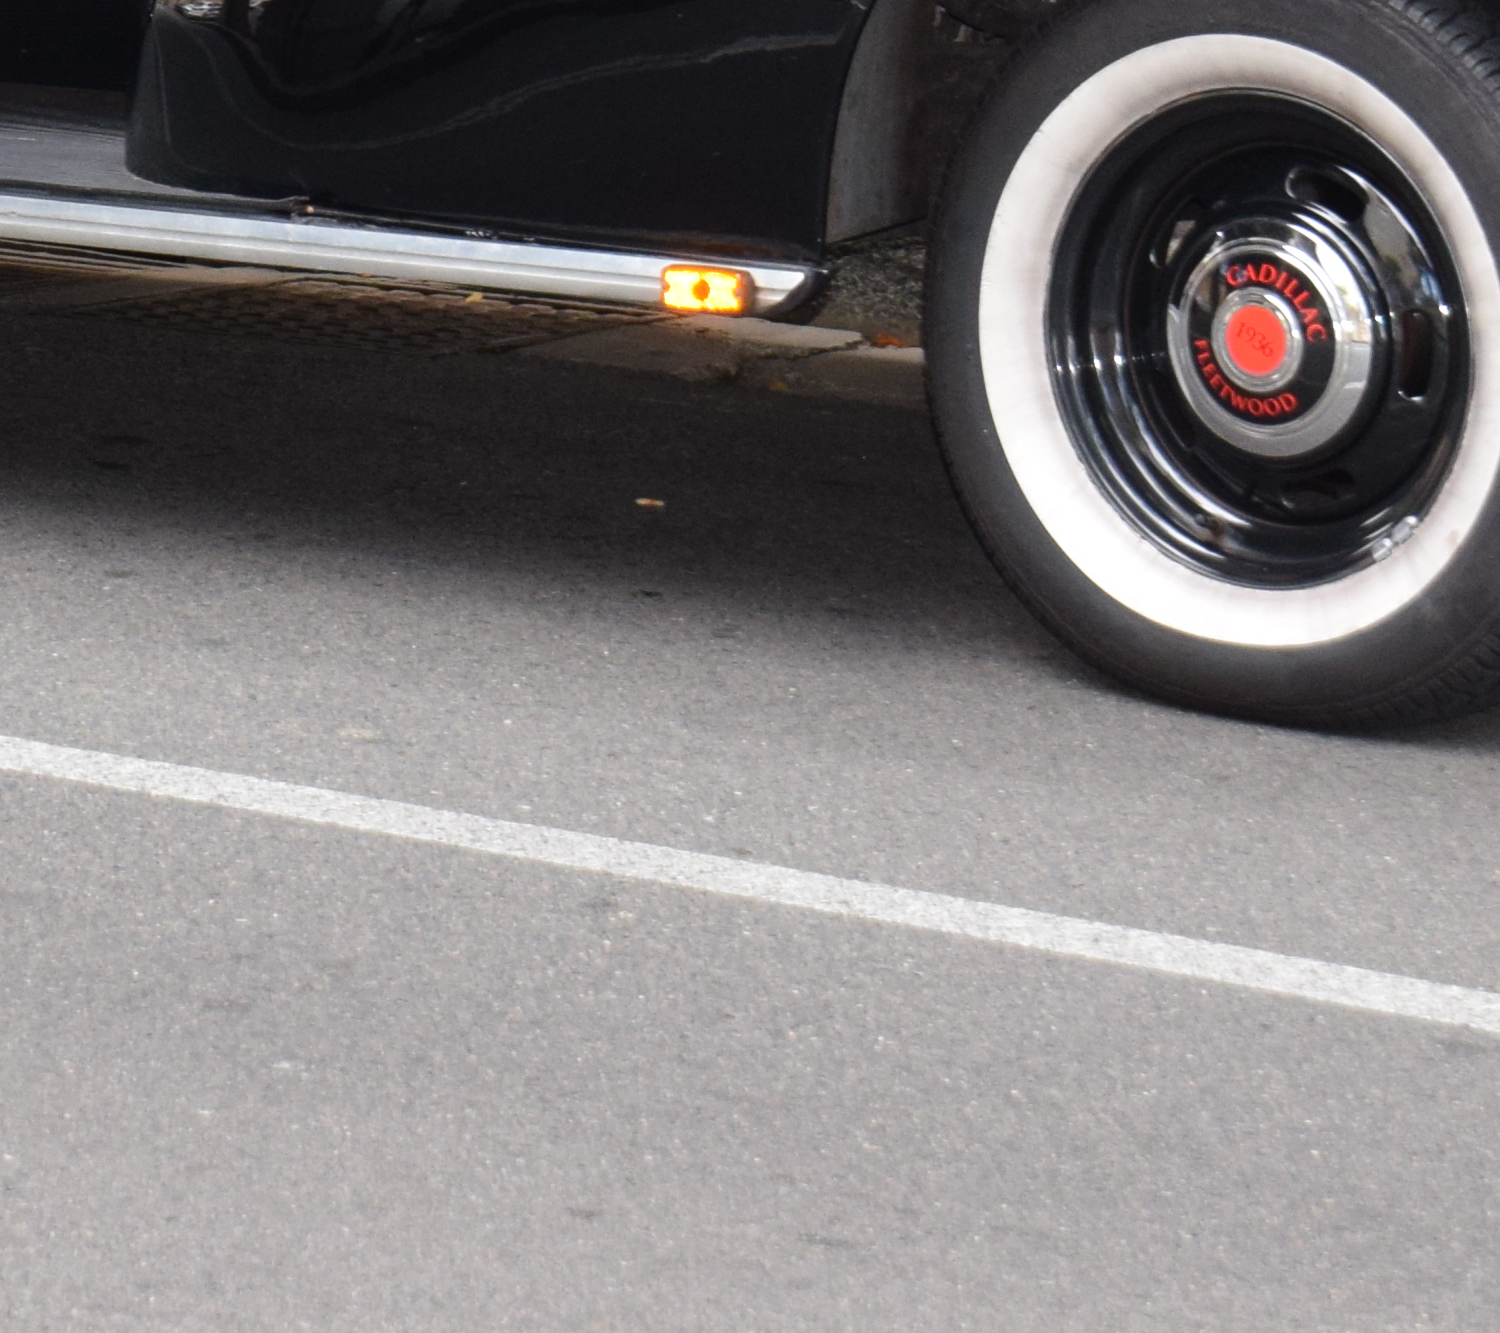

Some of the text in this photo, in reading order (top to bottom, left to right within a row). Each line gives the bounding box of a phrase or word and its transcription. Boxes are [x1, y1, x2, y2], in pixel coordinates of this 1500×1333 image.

[1226, 263, 1328, 343] CADILLAC
[1234, 321, 1274, 358] 1936
[1193, 339, 1298, 416] FLEETWOOD
